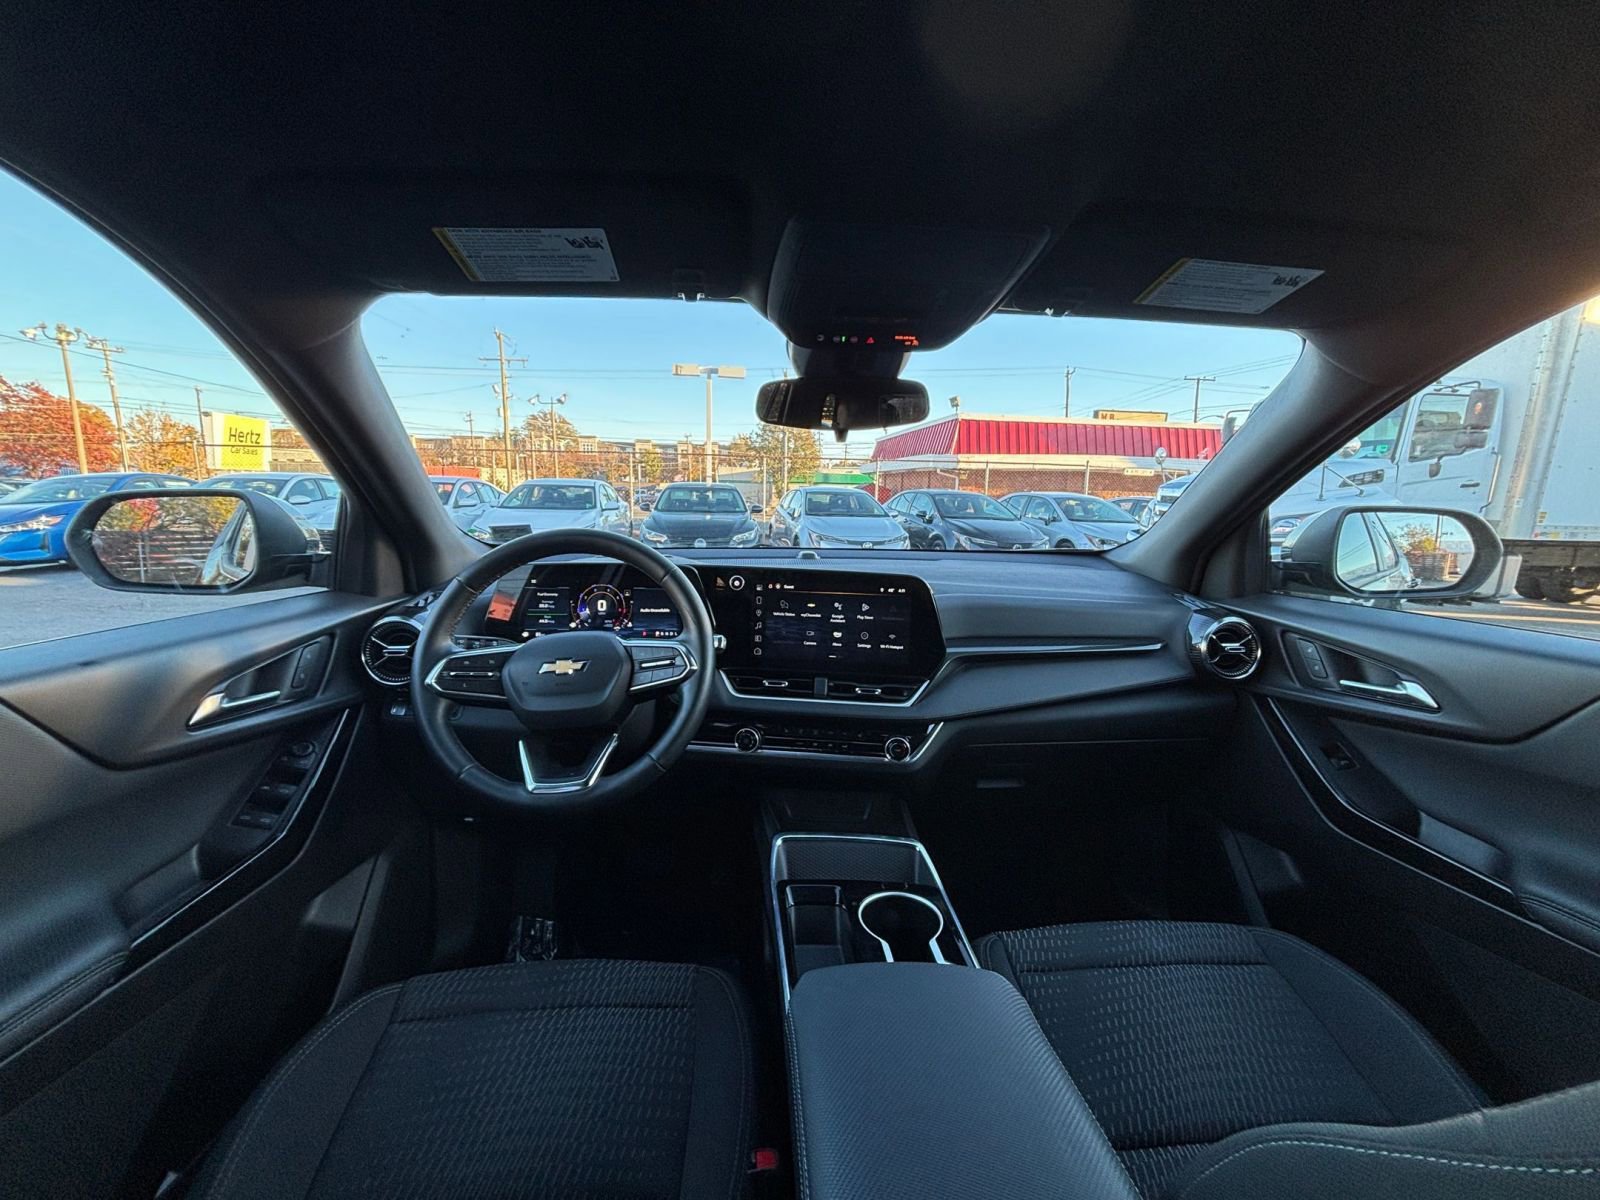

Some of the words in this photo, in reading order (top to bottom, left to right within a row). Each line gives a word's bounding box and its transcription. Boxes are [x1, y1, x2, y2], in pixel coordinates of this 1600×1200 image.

[228, 427, 261, 445] Hertz
[230, 446, 241, 454] Car
[242, 447, 258, 455] Sales
[597, 599, 607, 612] 0
